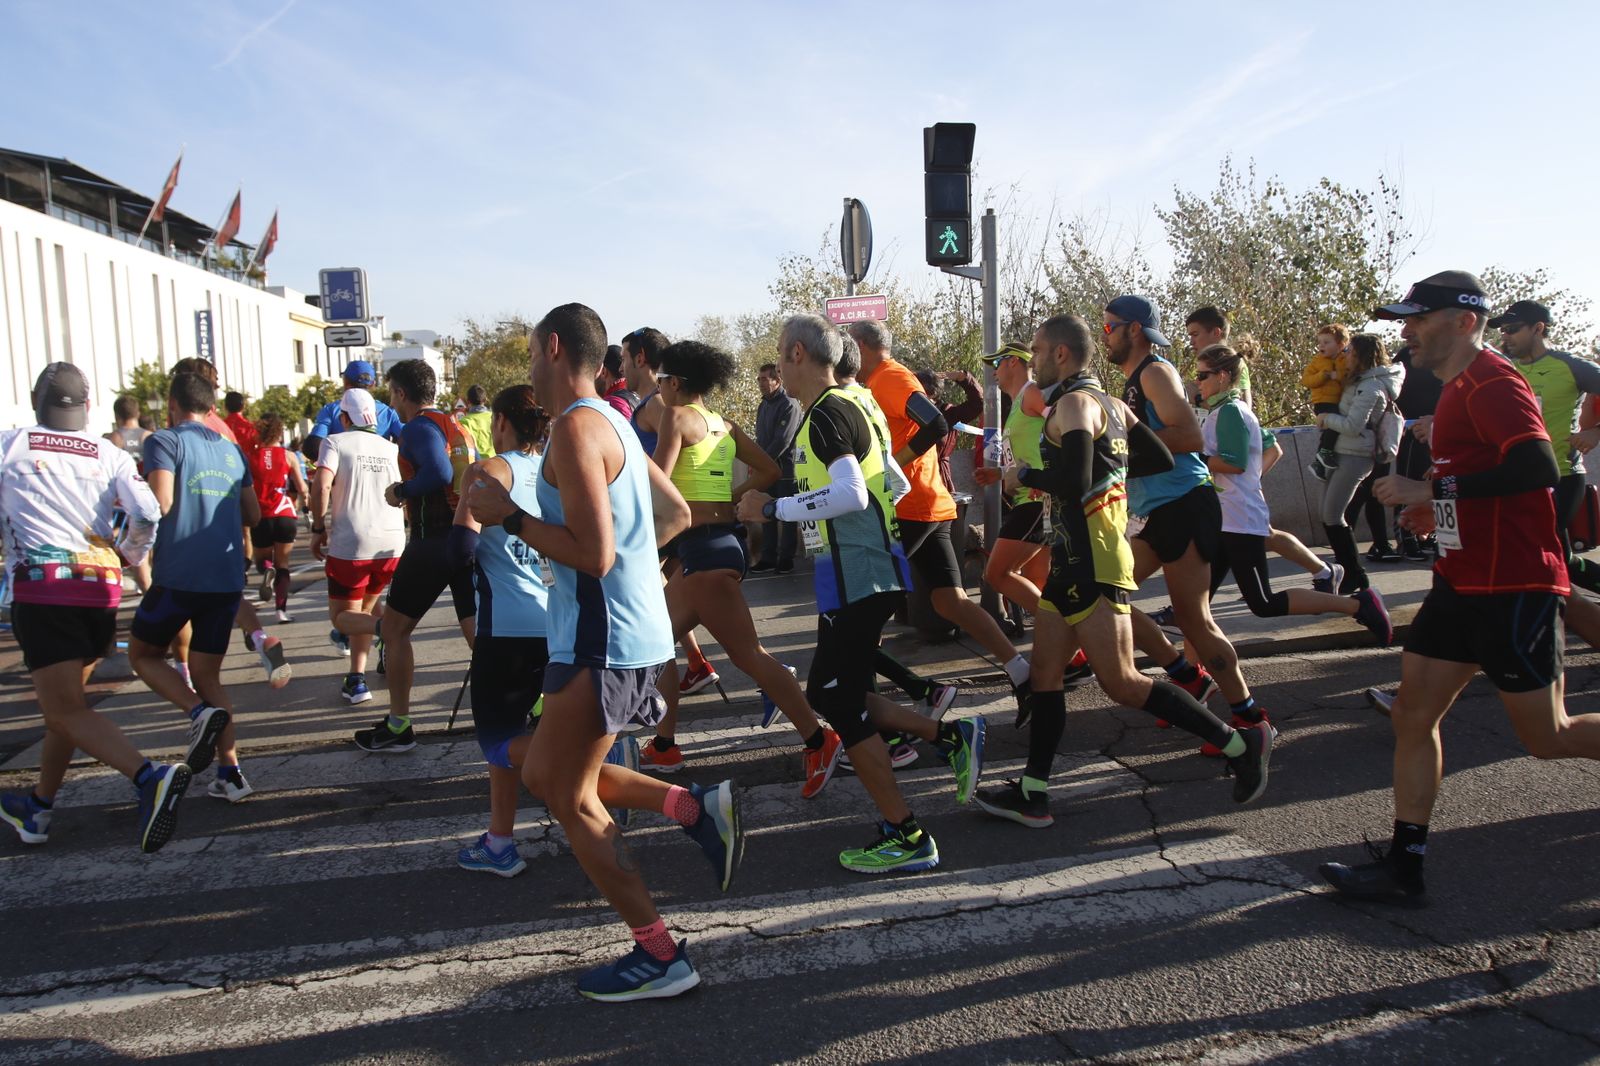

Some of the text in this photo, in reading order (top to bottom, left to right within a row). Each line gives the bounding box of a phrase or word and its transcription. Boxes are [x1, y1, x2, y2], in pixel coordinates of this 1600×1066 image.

[851, 299, 885, 308] AUTORIZADOS
[200, 311, 209, 357] PARKING
[46, 435, 98, 453] IMDECO
[187, 471, 206, 487] CLUB
[191, 488, 219, 497] PUERTO
